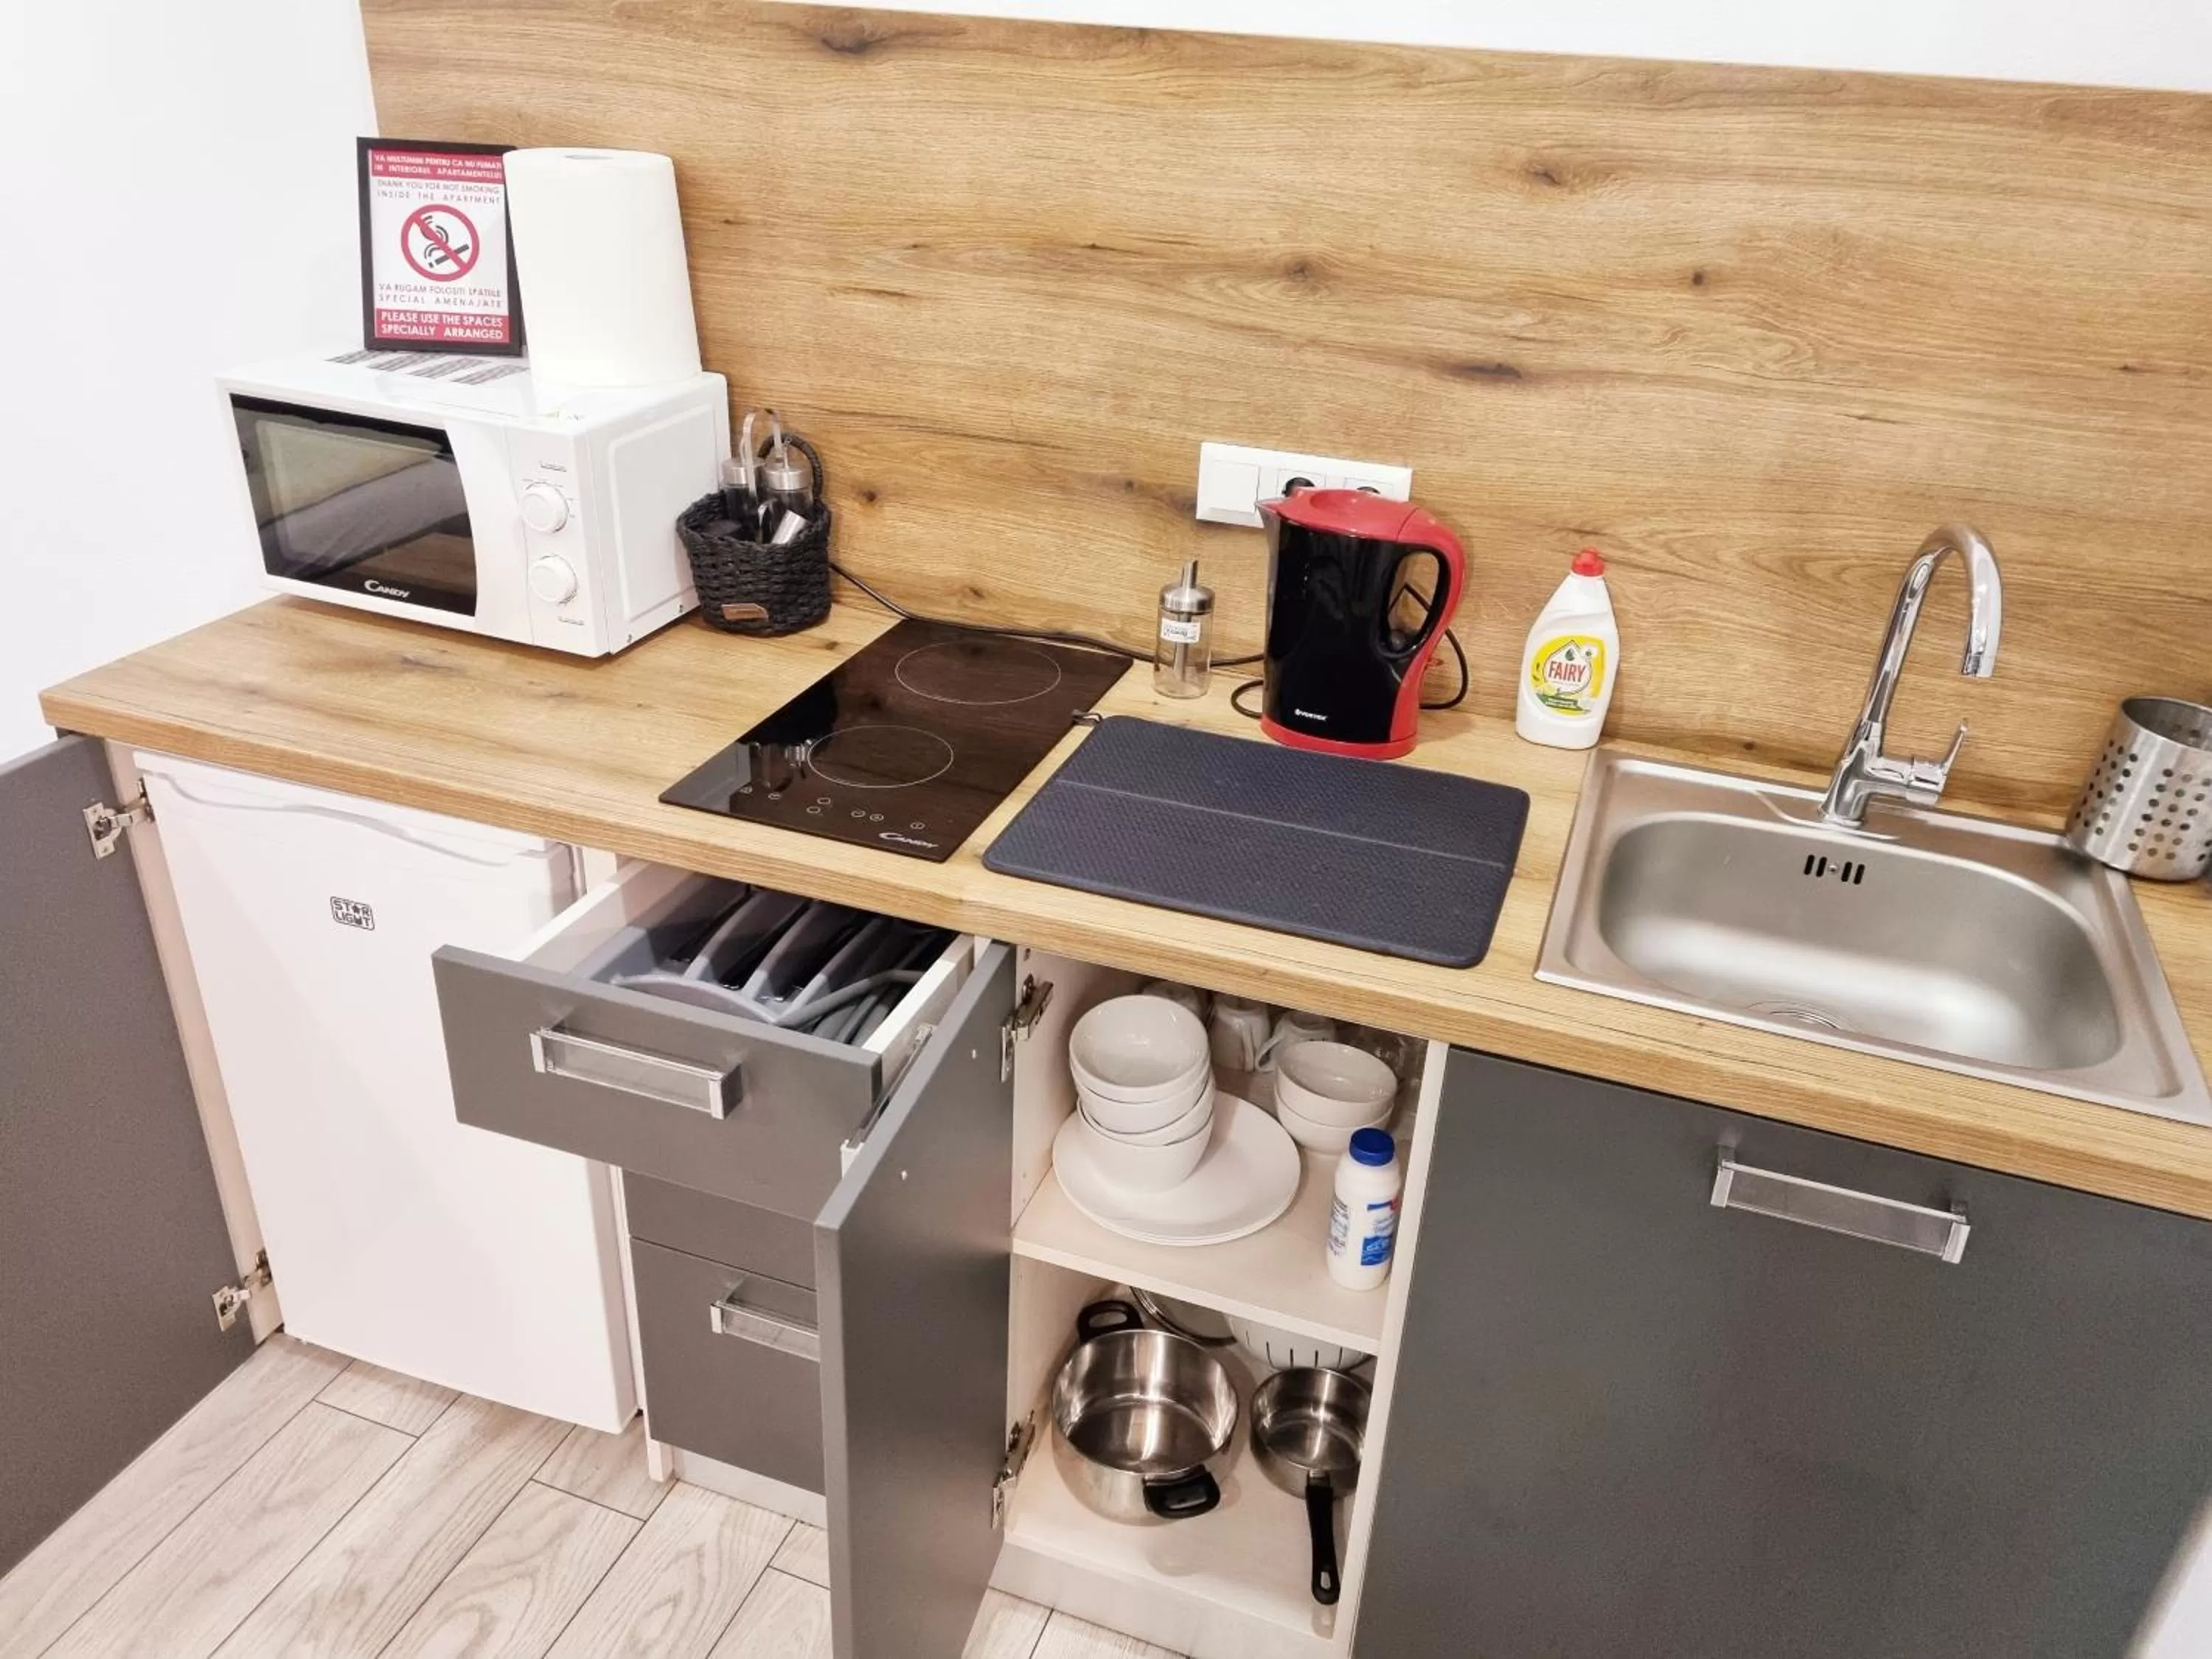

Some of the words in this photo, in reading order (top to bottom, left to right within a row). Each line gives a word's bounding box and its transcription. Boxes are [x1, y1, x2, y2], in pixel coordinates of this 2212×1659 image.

[452, 159, 463, 167] CA
[378, 179, 403, 187] THANK
[406, 181, 423, 189] YOU
[425, 182, 440, 190] FOR
[461, 184, 499, 194] SMOKING
[377, 191, 410, 199] INSIDE
[418, 192, 434, 201] THE
[442, 194, 499, 204] APARTMENT
[379, 283, 392, 291] VA
[394, 284, 427, 293] RUGAM
[378, 293, 425, 305] SPECIAL
[435, 296, 501, 307] AMENAJATE
[381, 311, 418, 322] PLEASE
[421, 313, 439, 324] USE
[442, 313, 462, 325] THE
[462, 315, 503, 327] SPACES
[381, 324, 436, 336] SPECIALLY
[444, 327, 503, 339] ARRANGED
[364, 580, 410, 598] CANDY
[1548, 660, 1587, 682] FAIRY
[879, 832, 939, 848] CANDY
